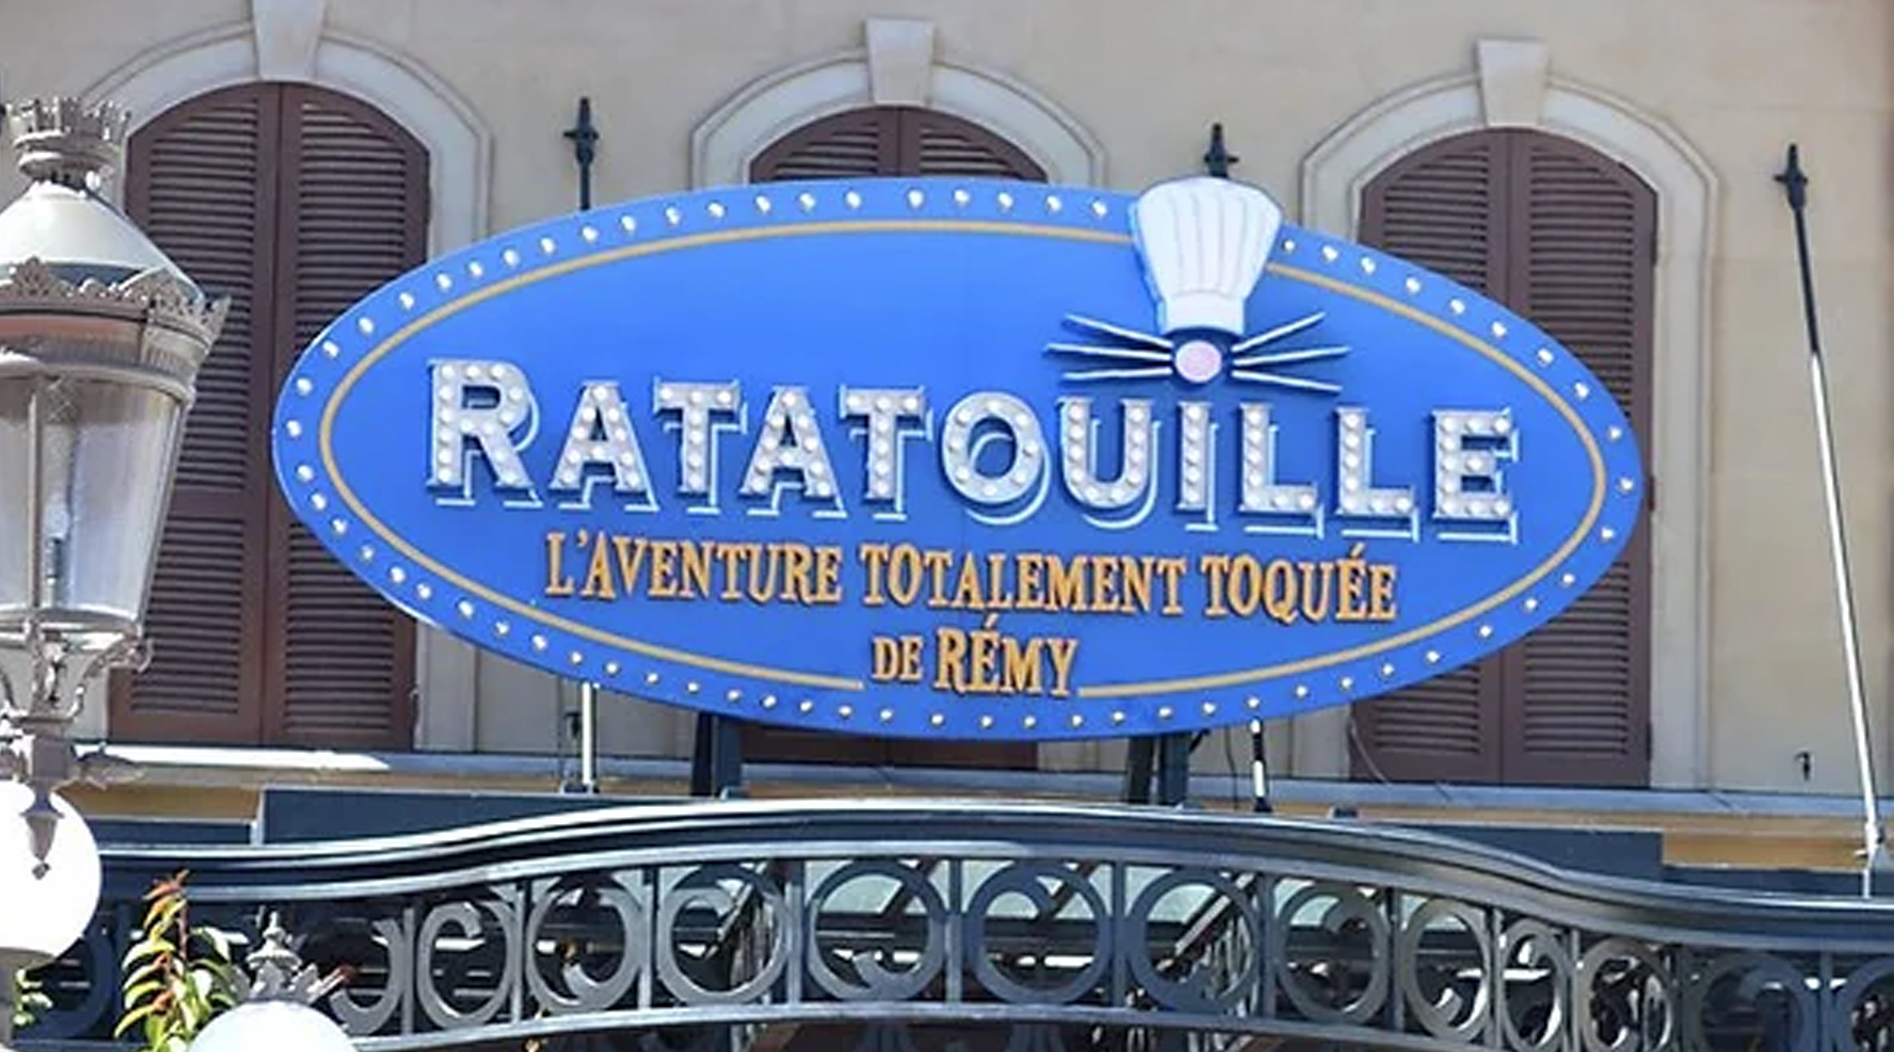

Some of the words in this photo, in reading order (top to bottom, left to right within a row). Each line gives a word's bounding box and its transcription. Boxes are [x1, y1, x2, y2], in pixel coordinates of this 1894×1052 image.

[427, 358, 1518, 542] RATATOUILLE
[546, 531, 843, 603] L'AVENTURE
[860, 545, 1188, 617] TOTALEMENT
[1201, 543, 1398, 625] TOQUÉE
[871, 635, 923, 682] DE
[934, 613, 1078, 697] RÉMY
